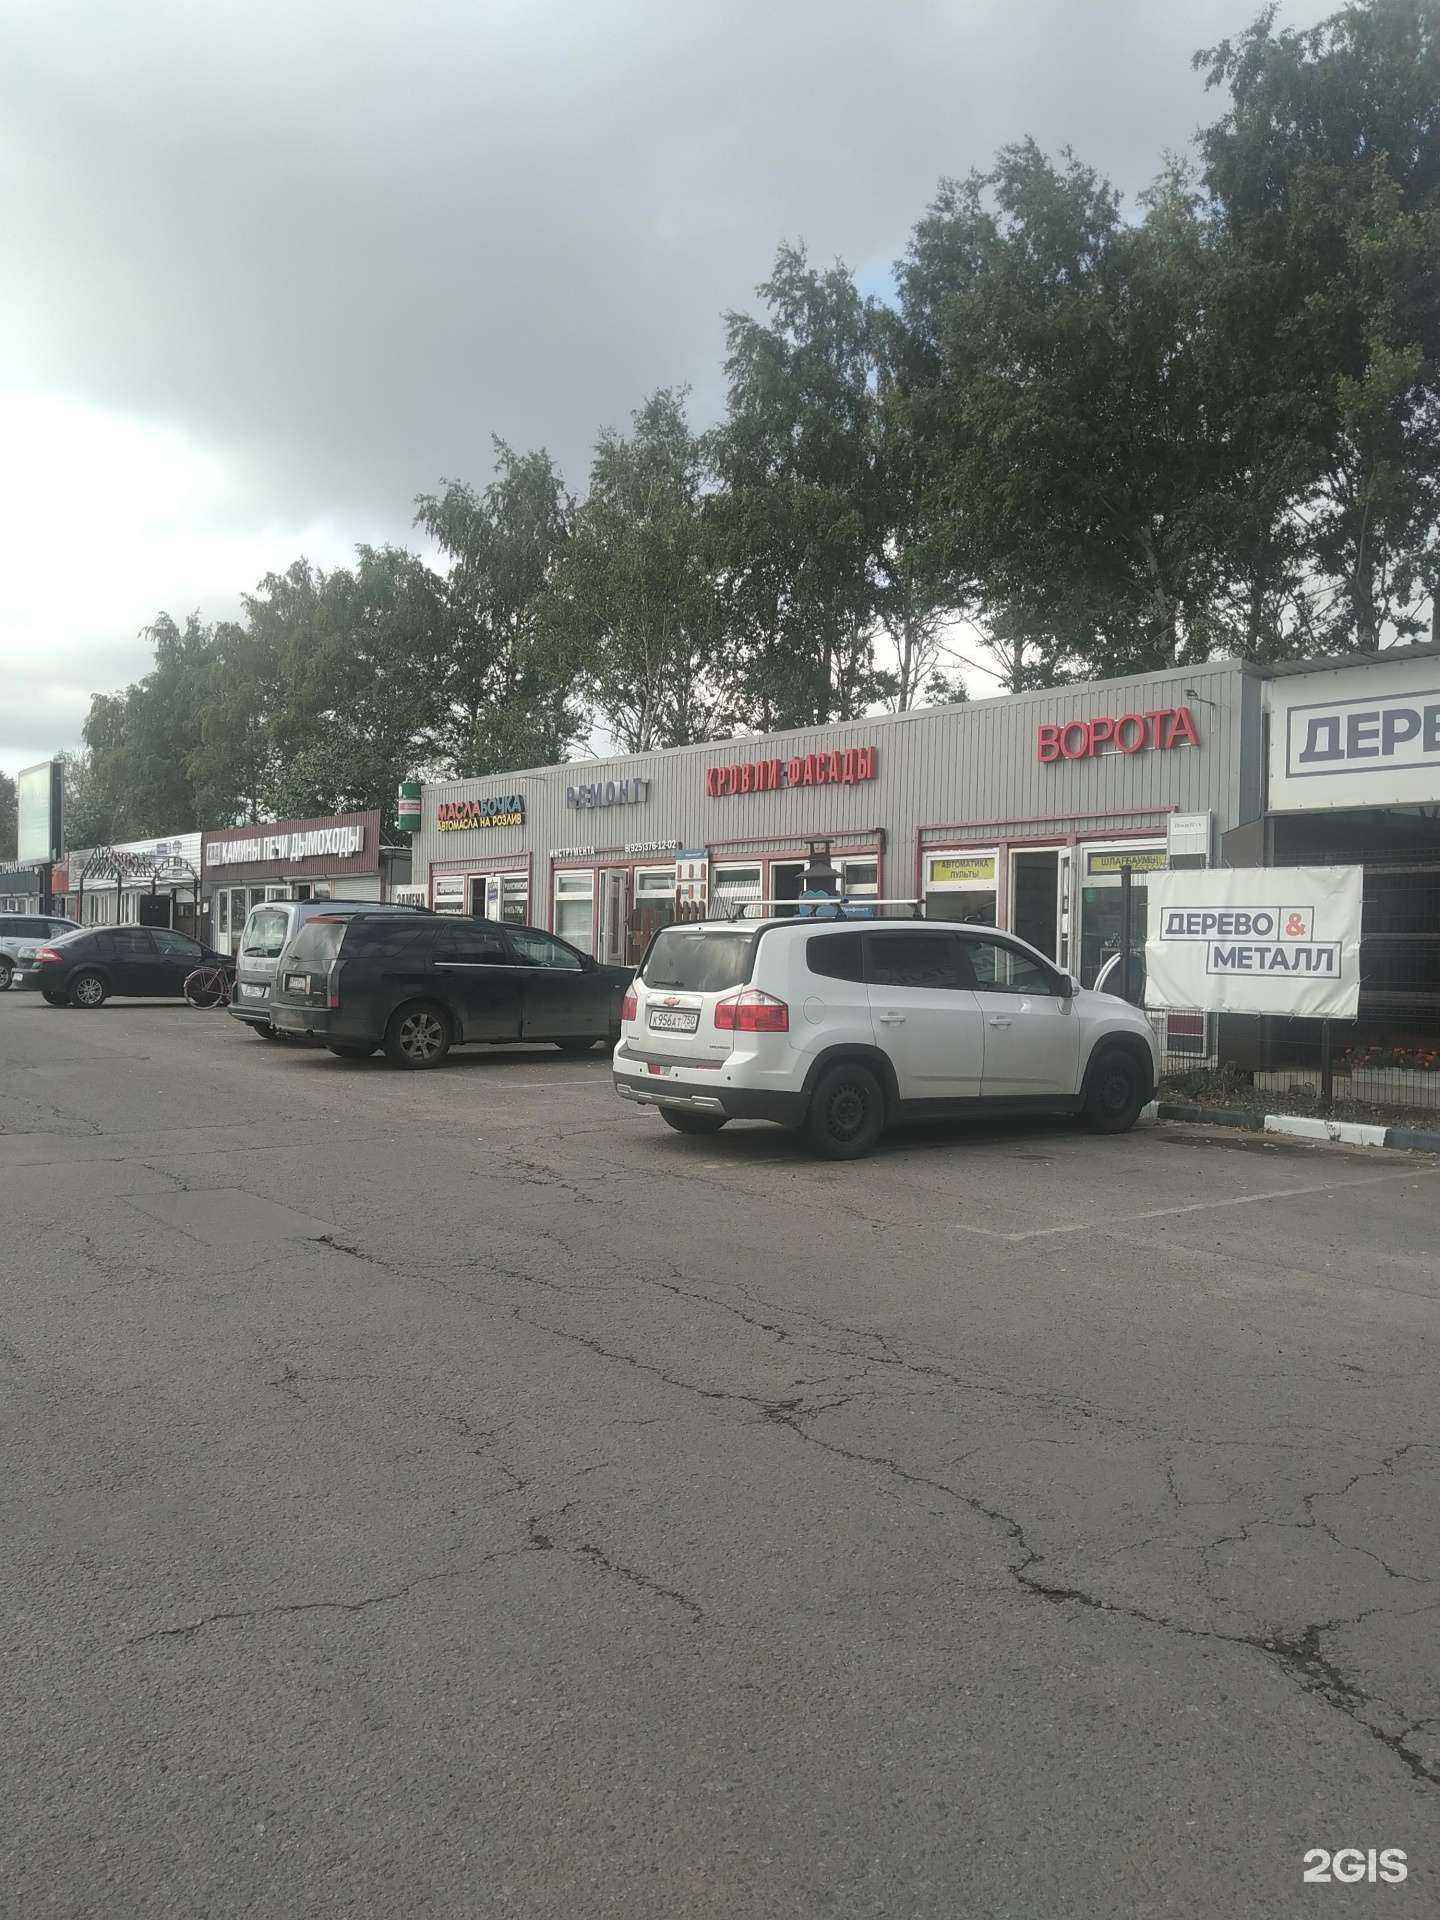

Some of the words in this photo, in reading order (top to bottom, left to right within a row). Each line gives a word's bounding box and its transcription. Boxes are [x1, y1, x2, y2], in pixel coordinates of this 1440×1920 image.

[1036, 706, 1200, 763] ВОРОТА
[567, 778, 645, 809] РЕМОНТ
[437, 817, 478, 832] АВТОМАСЛА
[480, 816, 491, 827] НА
[492, 813, 522, 827] РОЗЛИВ
[222, 838, 261, 864] КАМИНЫ
[263, 834, 290, 859] ПЕЧИ
[290, 826, 362, 861] ДЫМОХОДЫ
[550, 846, 595, 857] ИНСТРУМЕНТА
[941, 858, 989, 868] АВТОМАТИКА
[950, 869, 979, 880] ПУЛЬТЫ
[1164, 911, 1274, 936] ДЕРЕВО
[1285, 912, 1306, 936] &
[1213, 945, 1333, 971] МЕТАЛЛ
